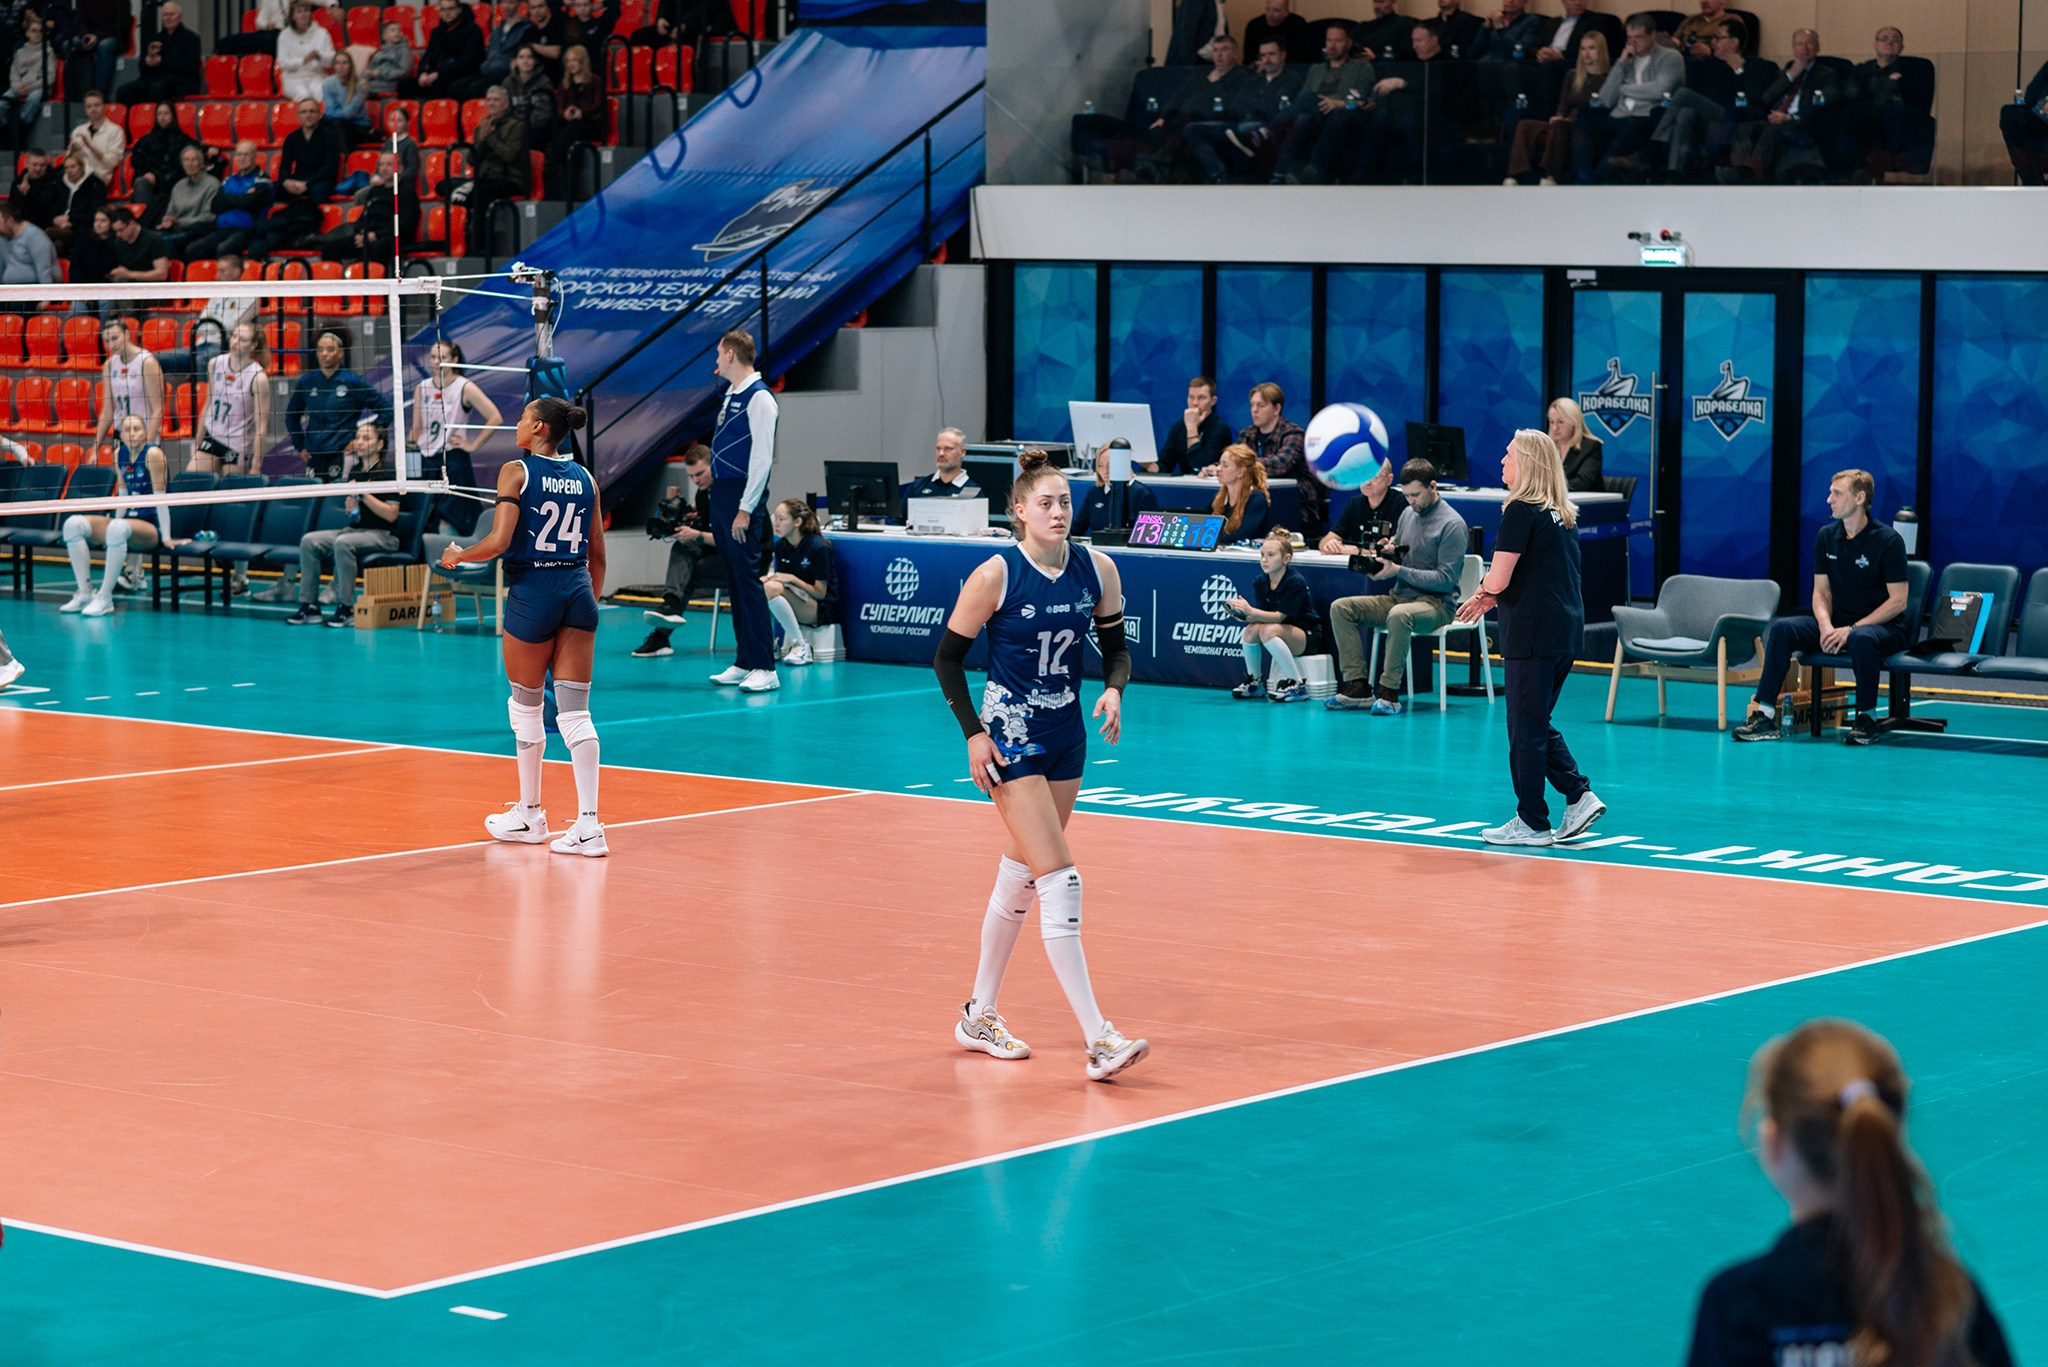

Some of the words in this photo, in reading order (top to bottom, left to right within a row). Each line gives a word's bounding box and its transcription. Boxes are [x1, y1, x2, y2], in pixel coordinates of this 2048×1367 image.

[214, 400, 232, 425] 17
[1582, 397, 1649, 414] КОРАБЕЛКА
[1697, 399, 1762, 416] КОРАБЕЛКА
[429, 420, 441, 442] 9
[542, 476, 583, 495] МОРЕНО
[535, 501, 583, 553] 24
[1138, 515, 1164, 523] MINSK
[1136, 524, 1160, 544] 13
[1190, 526, 1218, 547] 16
[860, 603, 945, 625] СУПЕРЛИГА
[870, 625, 906, 635] ЧЕМПИОНАТ
[906, 627, 931, 636] РОССИИ
[1172, 622, 1247, 644] СУПЕРЛИ
[1037, 629, 1075, 676] 12
[1184, 645, 1223, 656] ЧЕМПИОНАТ
[1223, 648, 1245, 657] РОССИ
